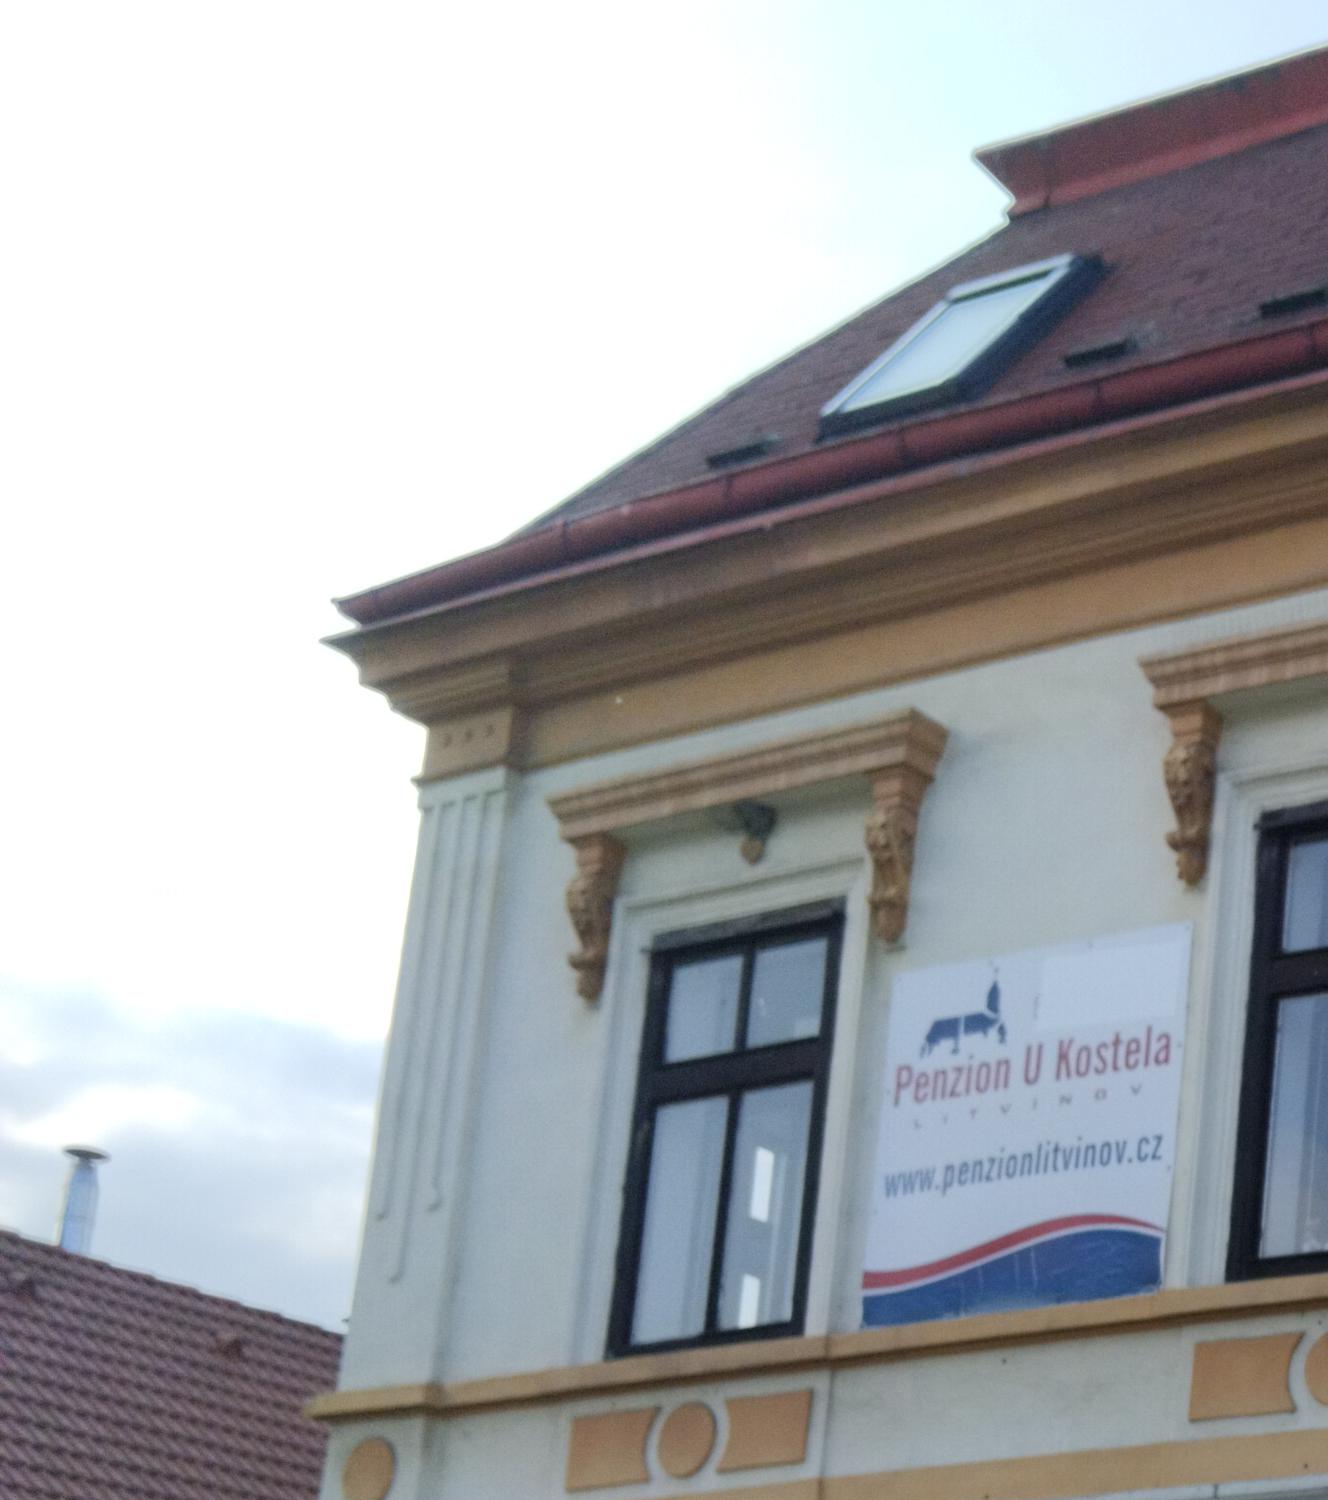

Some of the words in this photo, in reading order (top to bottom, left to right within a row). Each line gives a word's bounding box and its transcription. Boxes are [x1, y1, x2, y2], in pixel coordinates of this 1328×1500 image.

[893, 1054, 1011, 1107] Penzion
[1024, 1042, 1044, 1086] U
[1055, 1025, 1172, 1082] Kostela
[912, 1084, 1143, 1130] LITVINOV
[883, 1133, 1165, 1200] www.penzionlitvinov.cz
